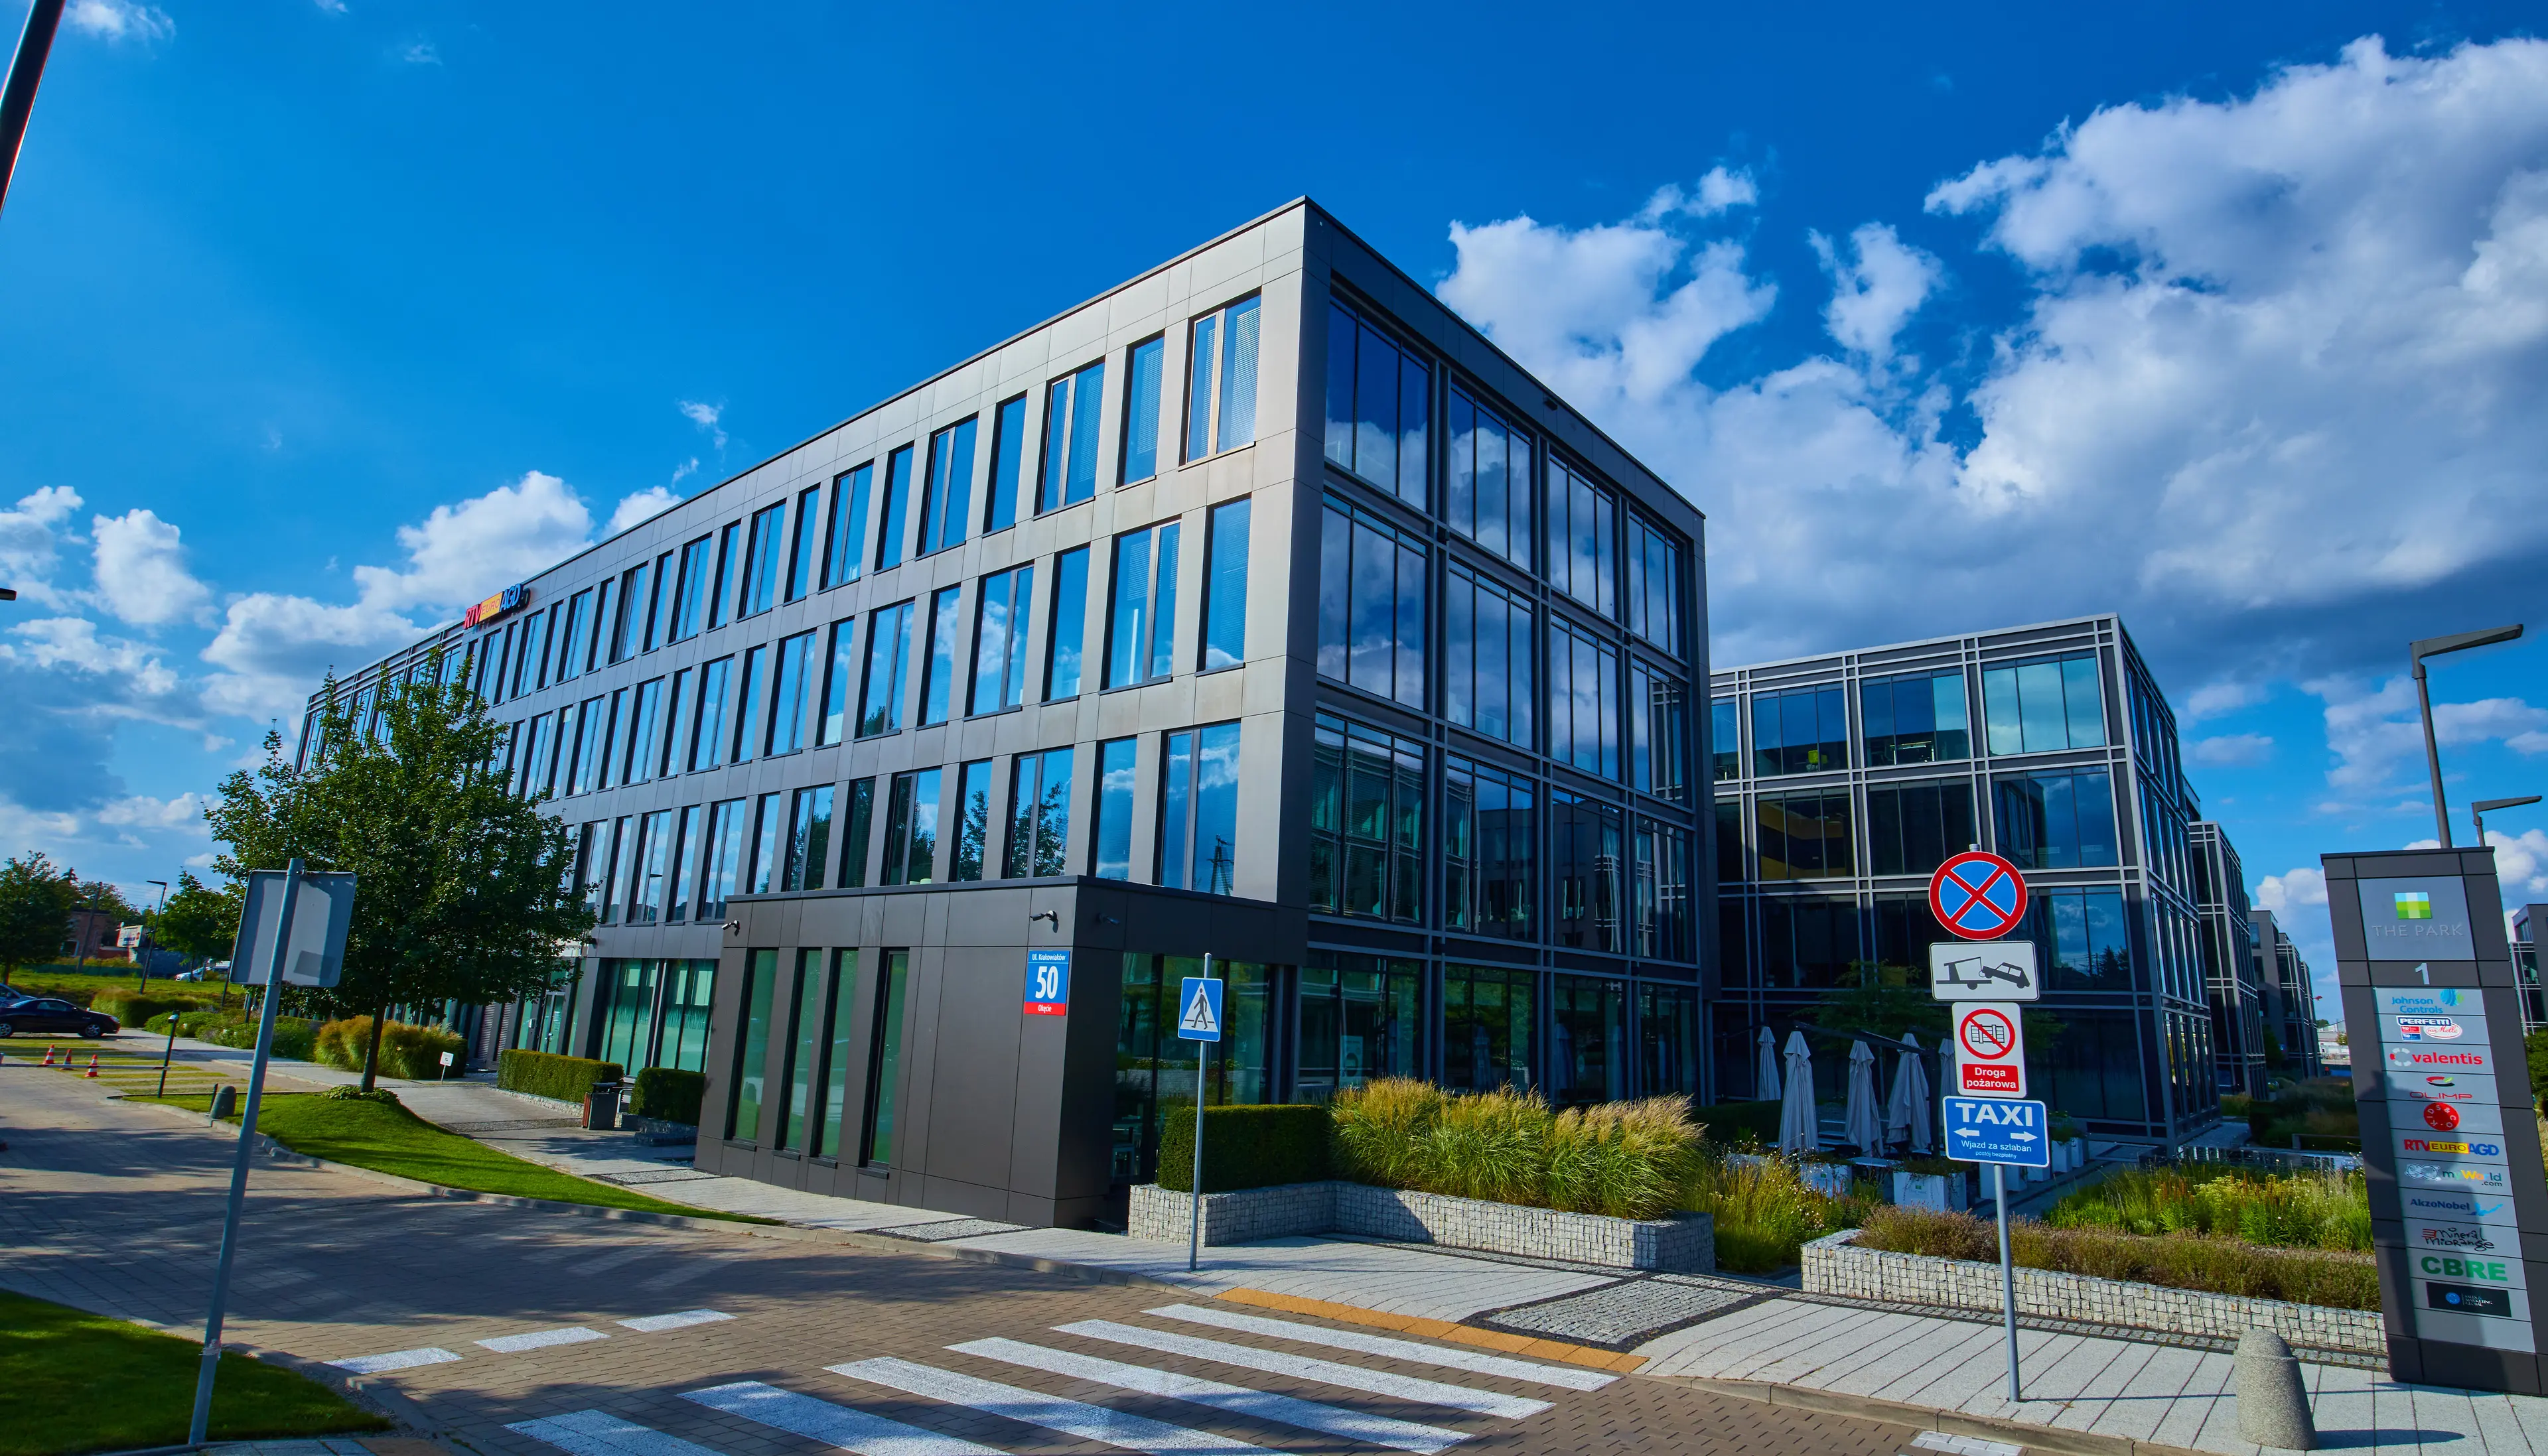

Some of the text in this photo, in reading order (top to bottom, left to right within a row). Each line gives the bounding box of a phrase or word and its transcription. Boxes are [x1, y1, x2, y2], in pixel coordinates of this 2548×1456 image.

[463, 584, 521, 629] RTV EURO AGD
[2371, 922, 2464, 937] THE PARK
[2415, 962, 2430, 985] 1
[1035, 966, 1058, 999] 50
[2391, 996, 2433, 1005] Johnson
[1038, 1004, 1052, 1014] Okęcie
[2399, 1005, 2443, 1014] Controls
[2412, 1052, 2483, 1065] valentis
[1975, 1067, 2006, 1079] Droga
[1966, 1079, 2017, 1088] pożarowa
[2409, 1091, 2473, 1100] OLIMP
[1955, 1102, 2033, 1127] TAXI
[1961, 1140, 1986, 1149] Wjazd
[1999, 1144, 2032, 1152] szlaban
[2404, 1139, 2500, 1156] RTV EURO AGD
[2442, 1169, 2502, 1182] myWorld
[2410, 1198, 2470, 1211] AkzoNobel
[2421, 1256, 2508, 1282] CBRE
